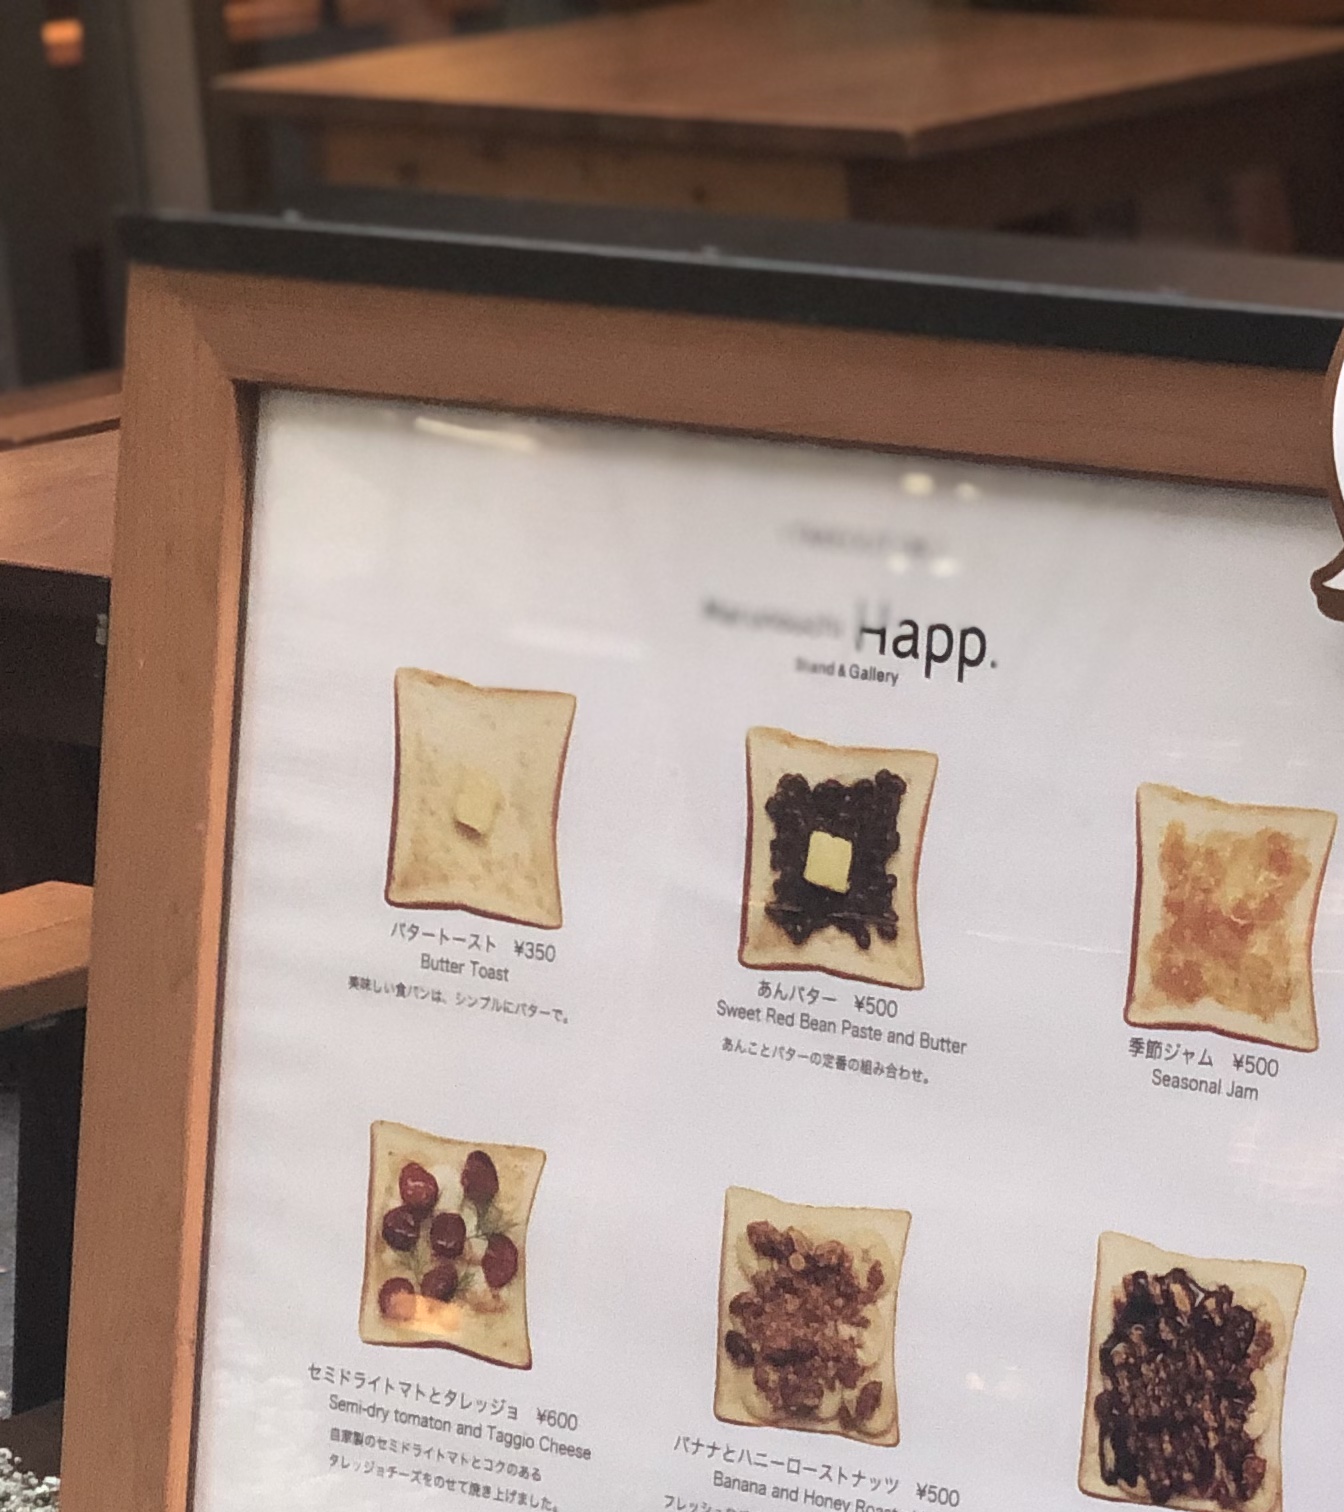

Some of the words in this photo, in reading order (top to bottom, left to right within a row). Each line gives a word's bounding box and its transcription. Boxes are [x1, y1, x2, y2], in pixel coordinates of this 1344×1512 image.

[849, 664, 898, 687] Gallery
[390, 922, 496, 952] バタートースト
[514, 940, 556, 962] ¥350
[421, 953, 465, 974] Butter
[471, 960, 509, 982] Toast
[758, 980, 837, 1005] あんバター
[854, 994, 898, 1018] ¥500
[716, 1000, 761, 1022] Sweet
[766, 1008, 794, 1027] Red
[800, 1013, 836, 1034] Bean
[841, 1019, 882, 1041] Paste
[887, 1030, 915, 1046] and
[920, 1032, 968, 1055] Butter
[1128, 1037, 1213, 1067] 季節ジャム
[1233, 1053, 1279, 1077] ¥500
[1152, 1069, 1221, 1095] Seasonal
[1226, 1081, 1258, 1101] Jam
[308, 1362, 518, 1420] セミドライトマトとタレッジョ
[536, 1407, 578, 1430] ¥600
[329, 1394, 390, 1422] Semi-dry
[394, 1409, 450, 1432] tomaton
[456, 1422, 482, 1438] and
[486, 1425, 534, 1449] Taggio
[539, 1435, 591, 1460] Cheese
[673, 1435, 899, 1495] バナナとハニーローストナッツ
[916, 1482, 961, 1507] ¥500
[713, 1471, 767, 1495] Banana
[772, 1485, 799, 1502] and
